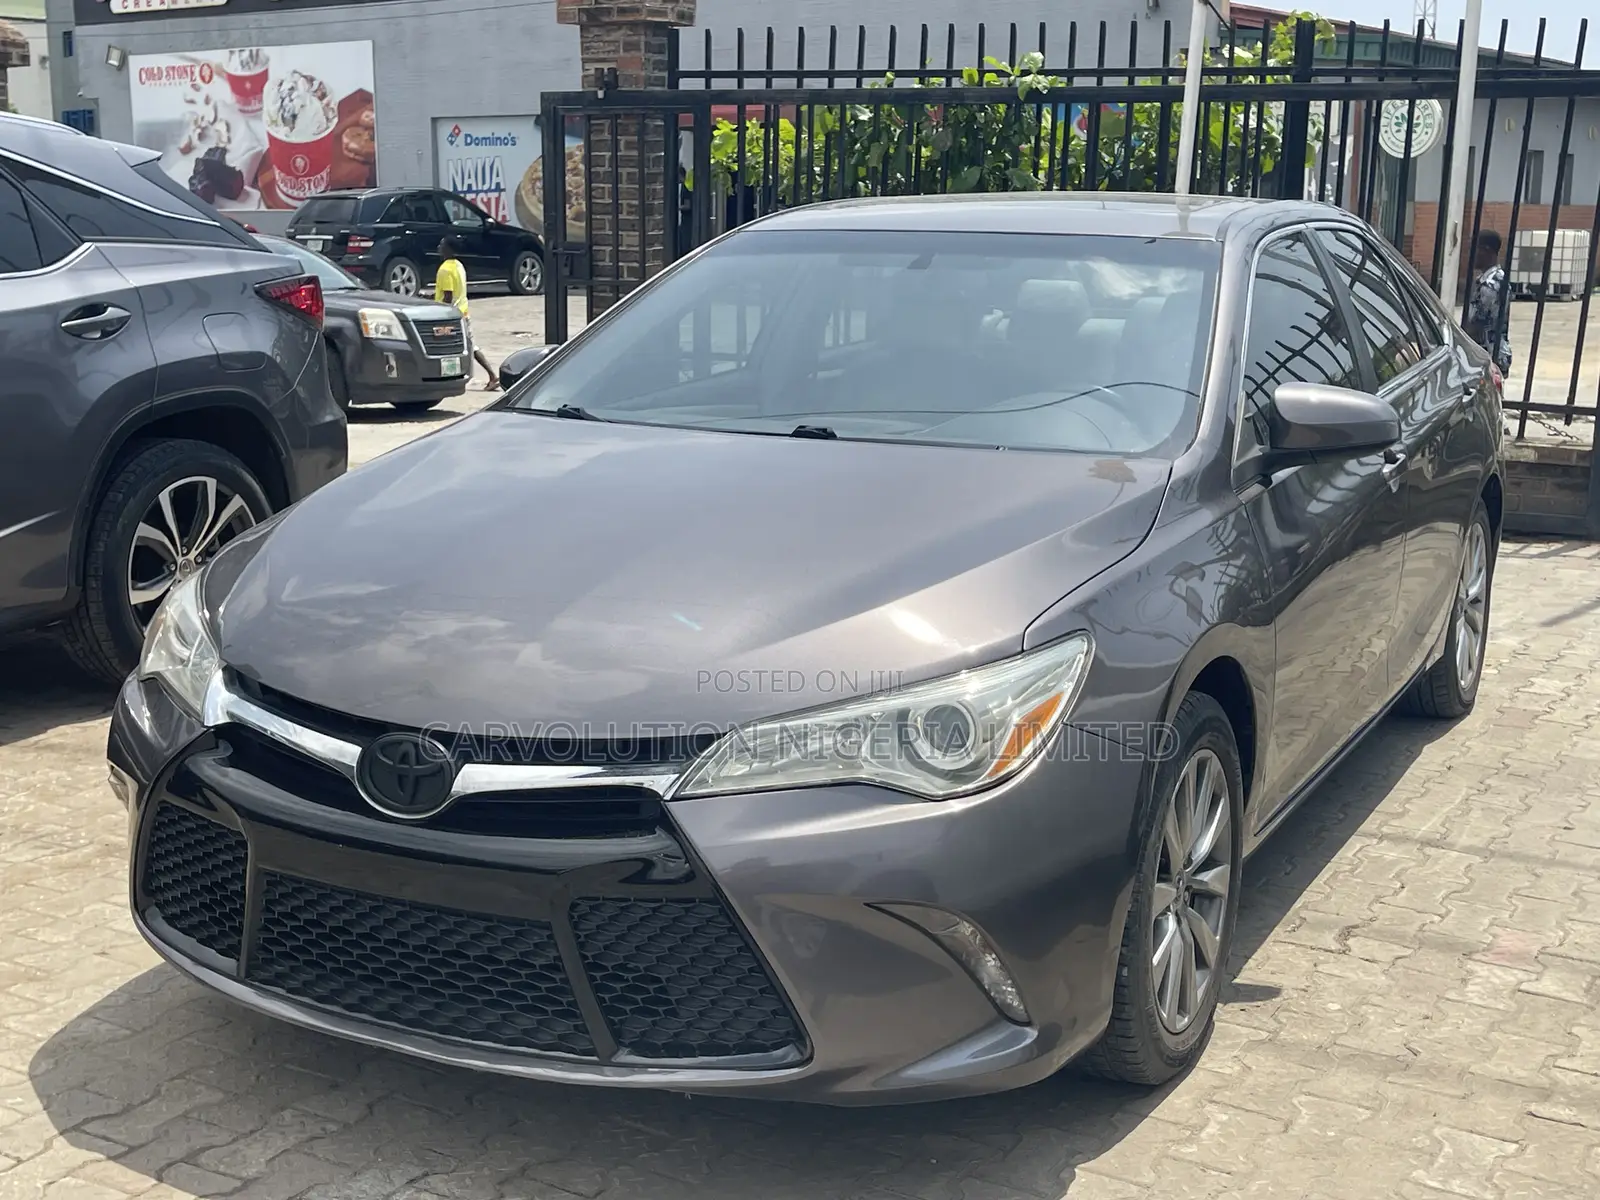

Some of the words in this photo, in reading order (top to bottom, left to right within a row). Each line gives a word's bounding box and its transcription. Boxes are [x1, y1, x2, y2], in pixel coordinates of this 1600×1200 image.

[138, 66, 164, 85] COLD
[165, 64, 197, 82] STONE
[1382, 99, 1433, 128] LIFESORES
[464, 131, 517, 147] Domino's
[447, 155, 506, 191] NAIJA
